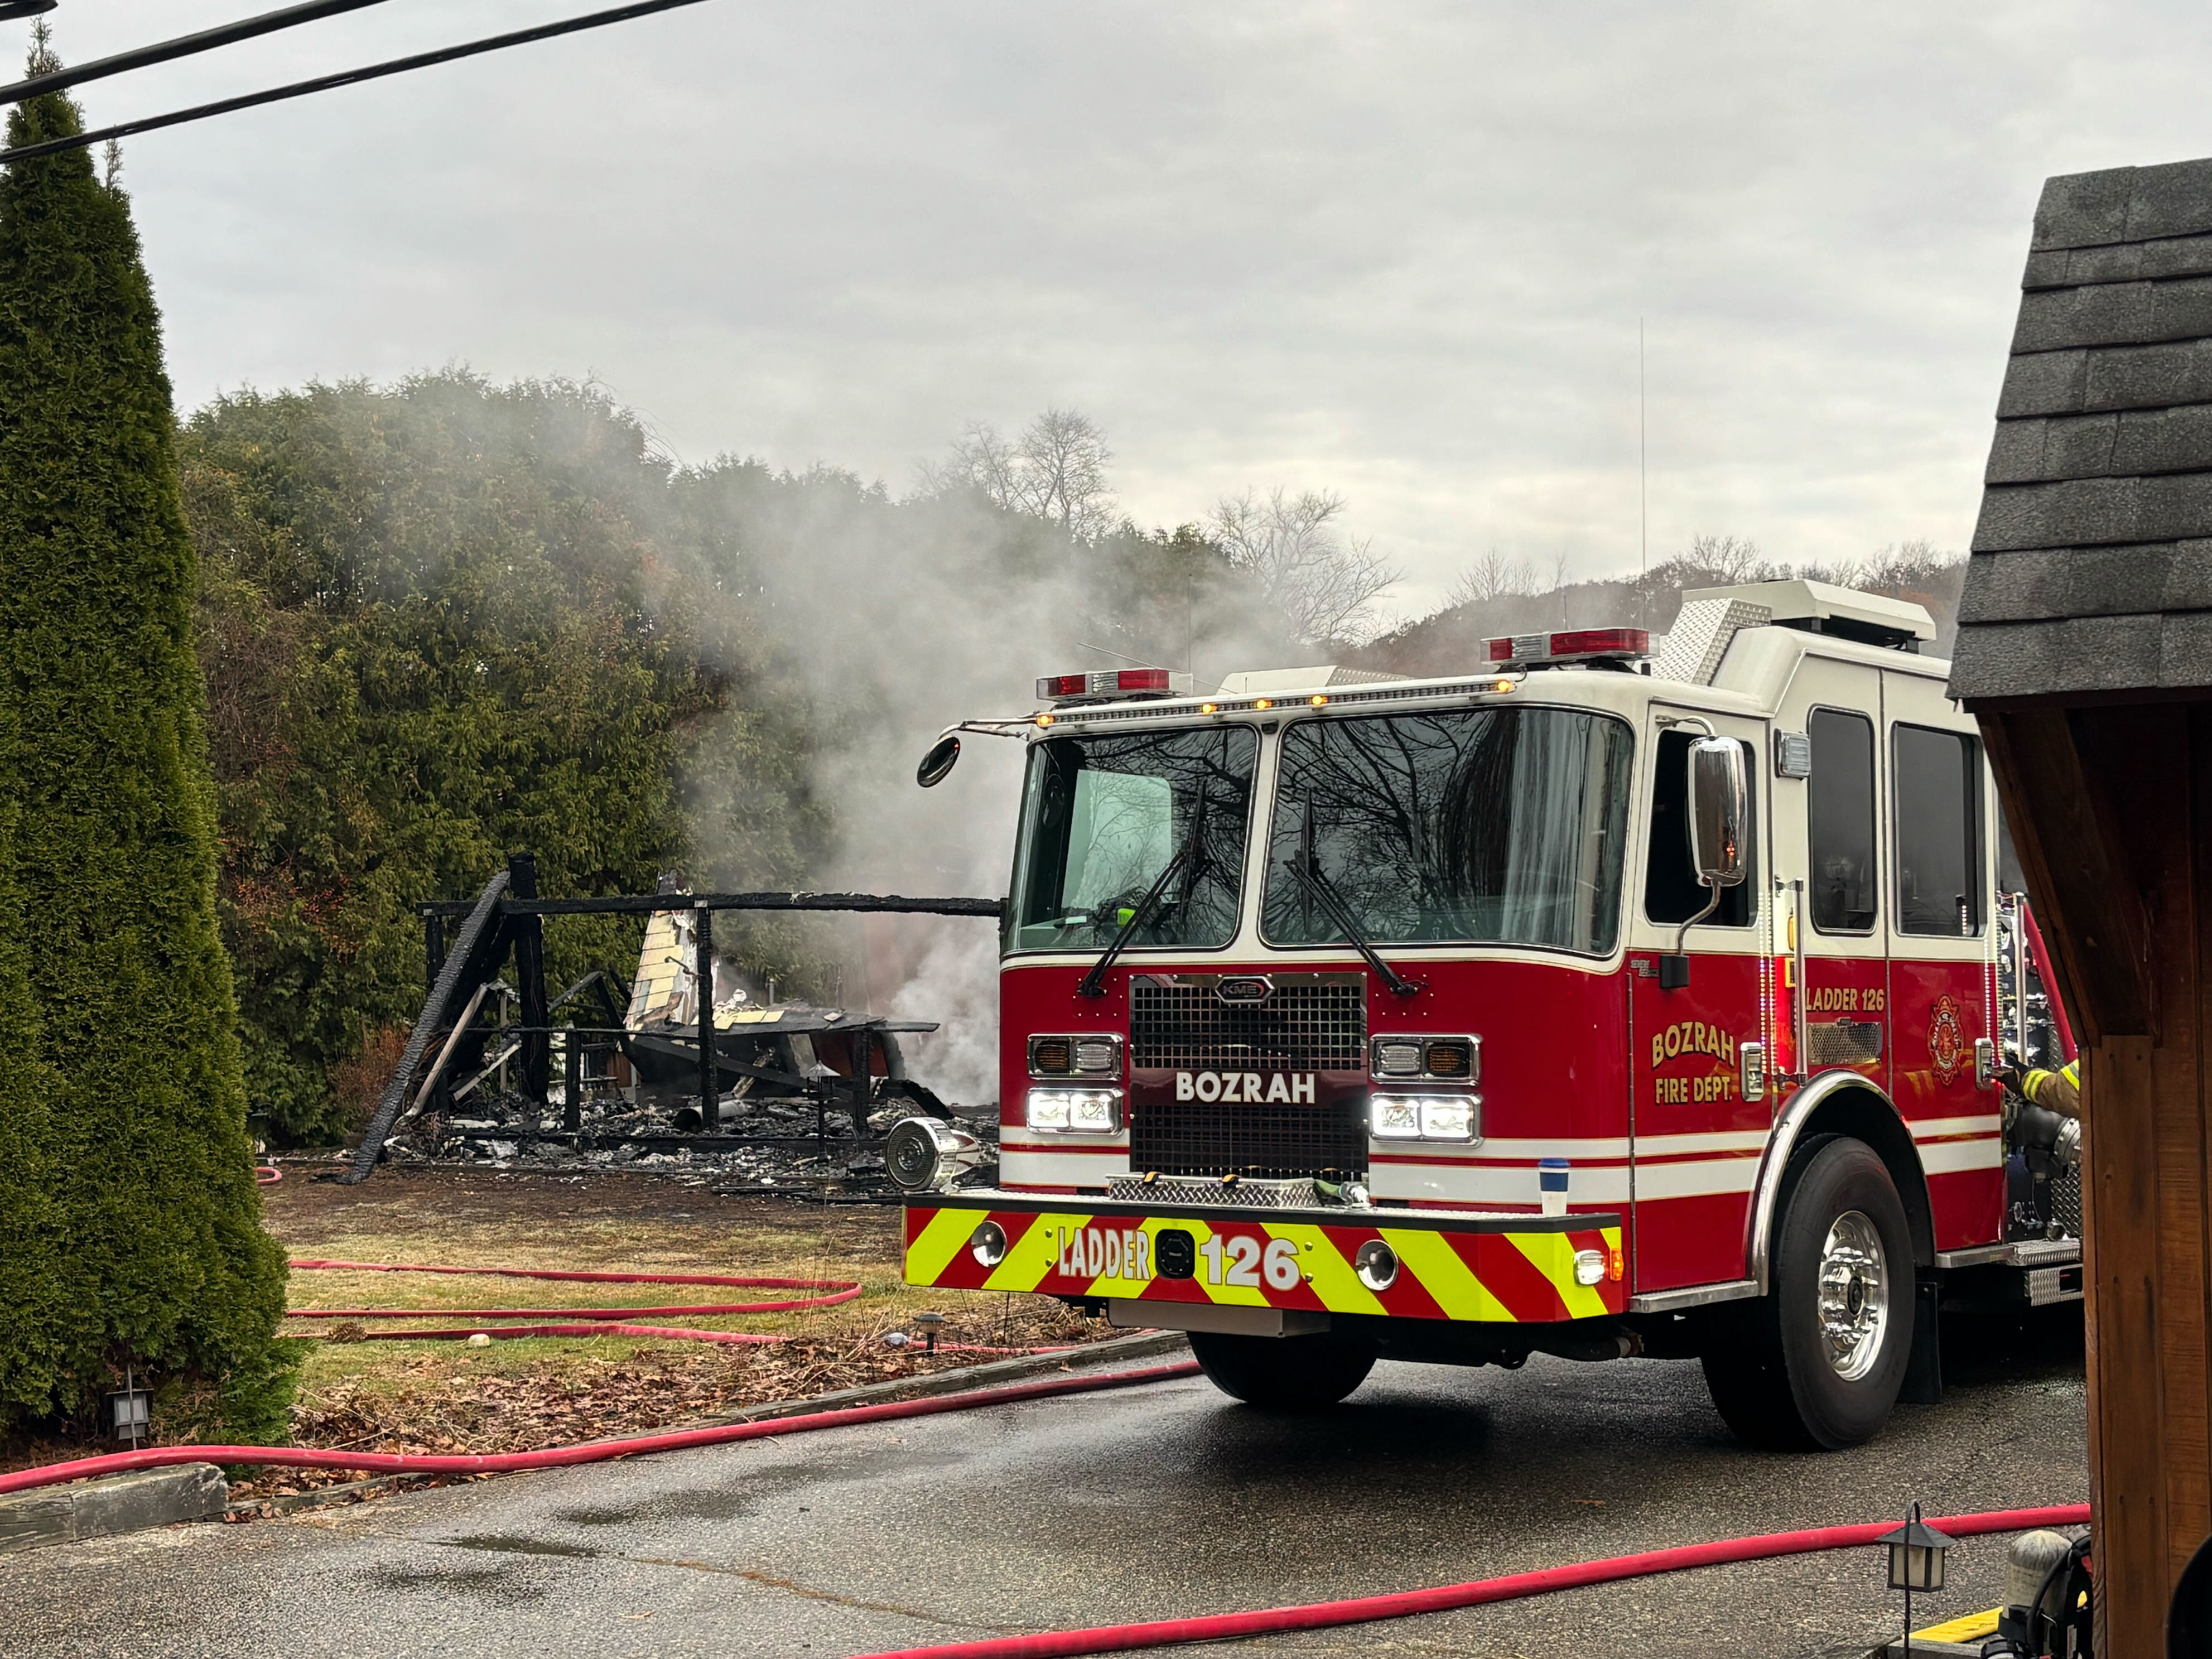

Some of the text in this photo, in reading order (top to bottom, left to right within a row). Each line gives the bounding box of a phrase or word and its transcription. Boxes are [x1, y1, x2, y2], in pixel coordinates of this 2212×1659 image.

[1223, 985, 1257, 994] KME
[1806, 987, 1885, 1011] LADDER 126
[1652, 1021, 1735, 1069] BOZRAH
[1176, 1071, 1315, 1104] BOZRAH
[1655, 1076, 1733, 1104] FIRE DEPT.
[1058, 1226, 1300, 1291] LADDER 126
